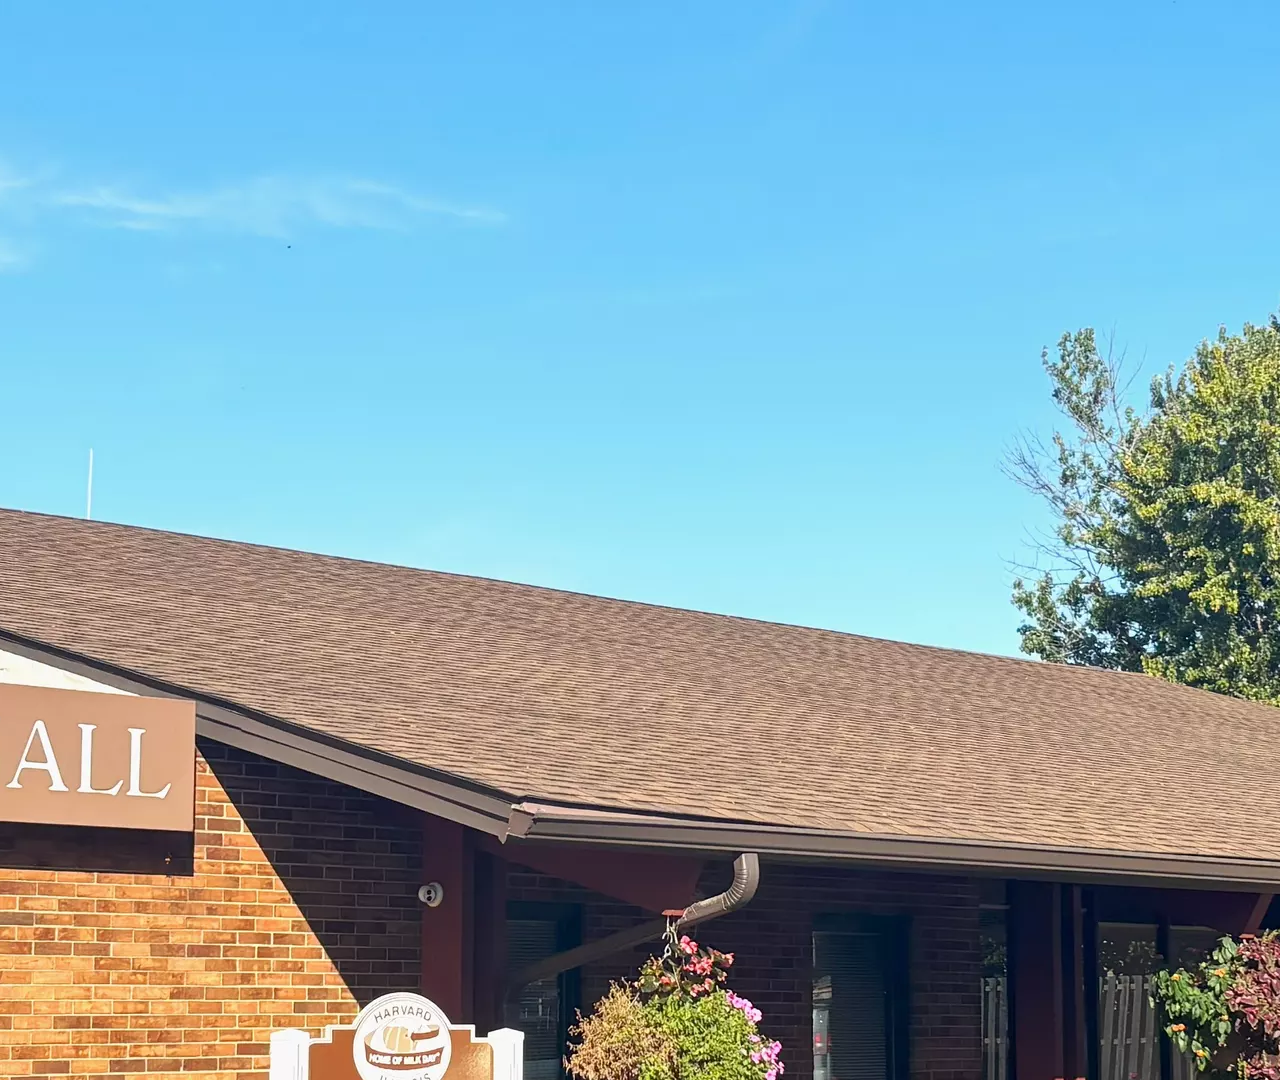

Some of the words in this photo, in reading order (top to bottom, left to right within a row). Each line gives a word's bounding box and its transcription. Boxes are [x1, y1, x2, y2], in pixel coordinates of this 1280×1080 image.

[374, 1005, 432, 1024] HARVARD
[368, 1052, 392, 1065] HOME
[392, 1055, 403, 1065] OF
[403, 1055, 422, 1065] MILK
